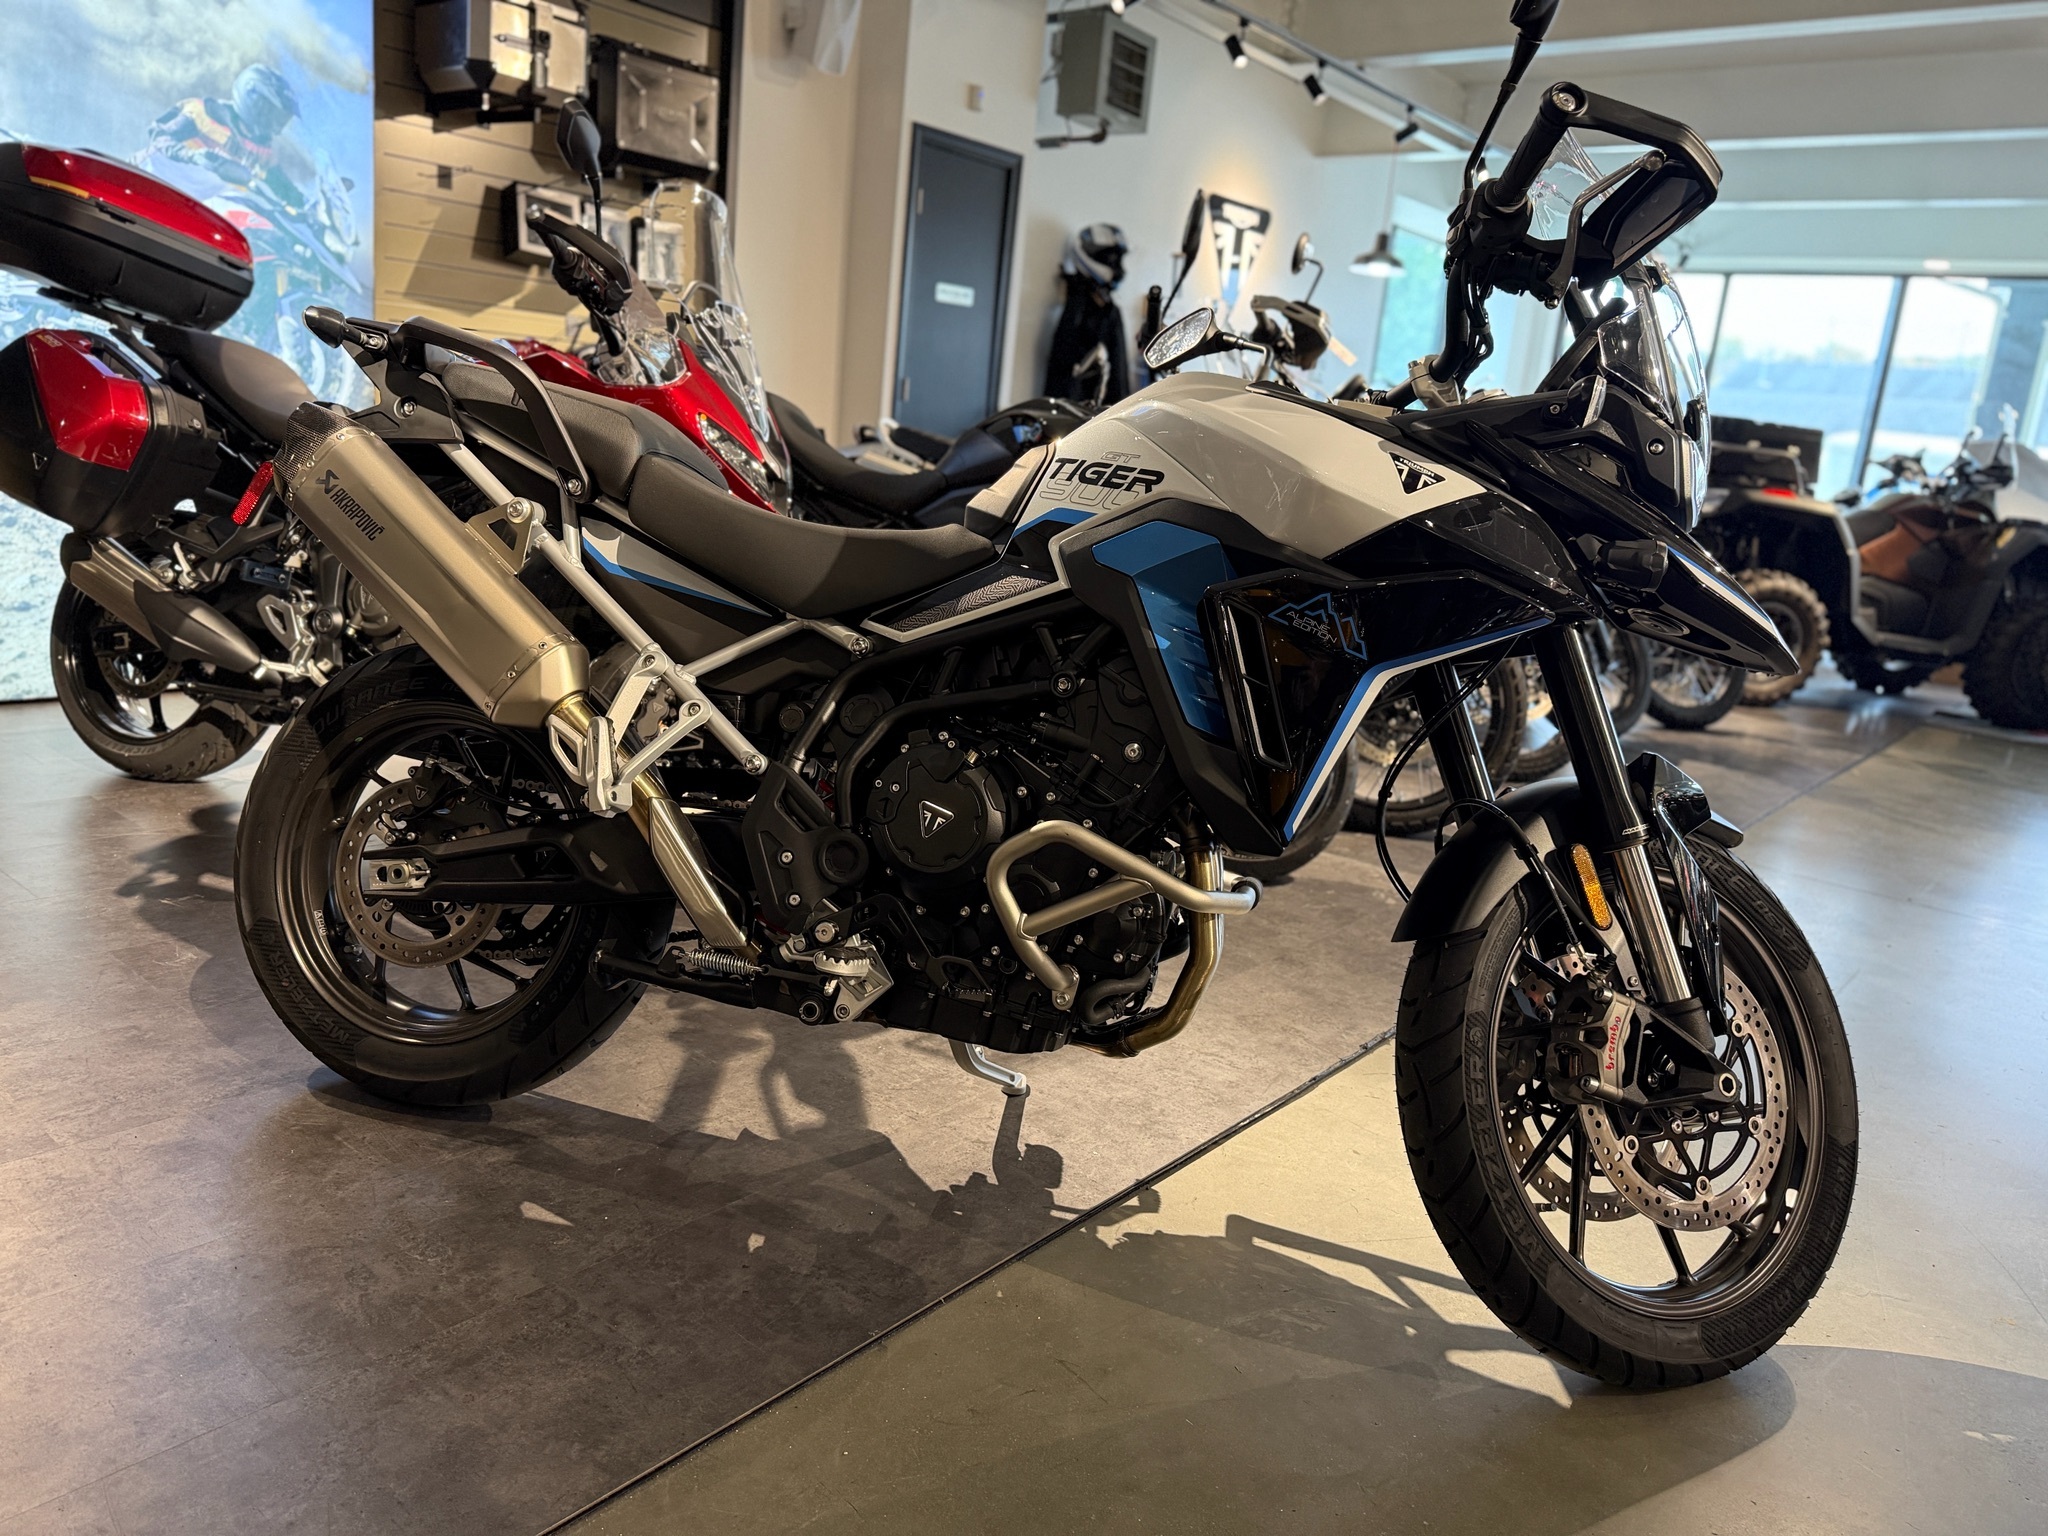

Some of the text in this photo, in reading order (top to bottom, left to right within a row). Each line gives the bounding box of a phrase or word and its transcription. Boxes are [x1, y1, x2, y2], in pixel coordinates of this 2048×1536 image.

[1100, 451, 1141, 463] GT
[1400, 457, 1435, 477] TRIUMPH
[1049, 458, 1165, 494] TIGER
[1286, 611, 1330, 631] ALPINE
[1292, 619, 1338, 643] EDITION
[1605, 1016, 1621, 1071] brembo
